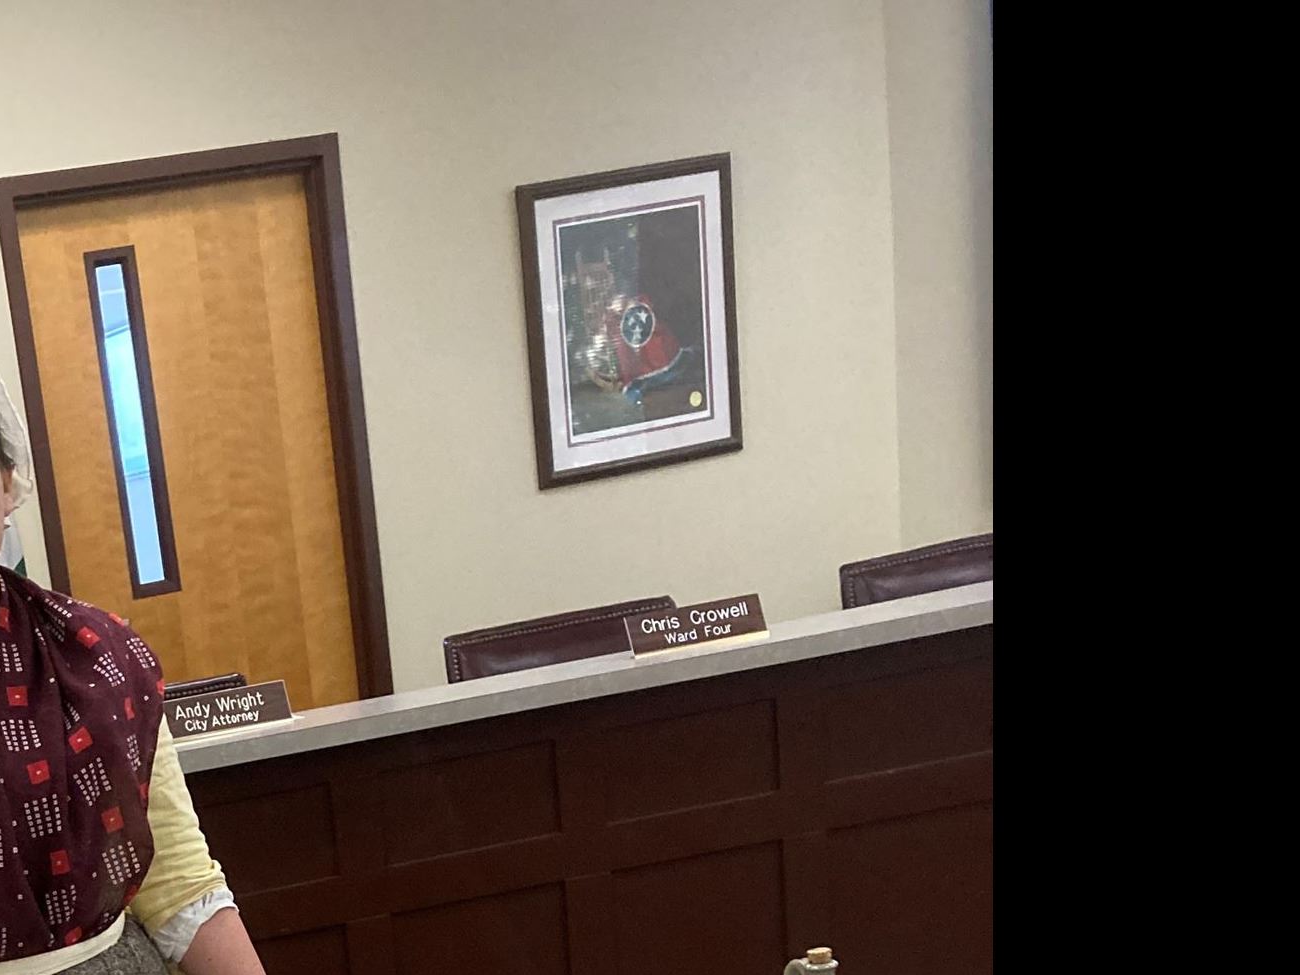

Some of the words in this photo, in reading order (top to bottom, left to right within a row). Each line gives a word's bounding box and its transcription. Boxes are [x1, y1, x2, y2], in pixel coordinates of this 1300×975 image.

[641, 616, 680, 634] Chris
[690, 602, 748, 625] Crowell
[664, 629, 697, 644] Ward
[704, 623, 732, 637] Four
[175, 702, 210, 720] Andy
[216, 691, 265, 712] Wright
[185, 718, 207, 732] City
[212, 710, 259, 727] Attorney
